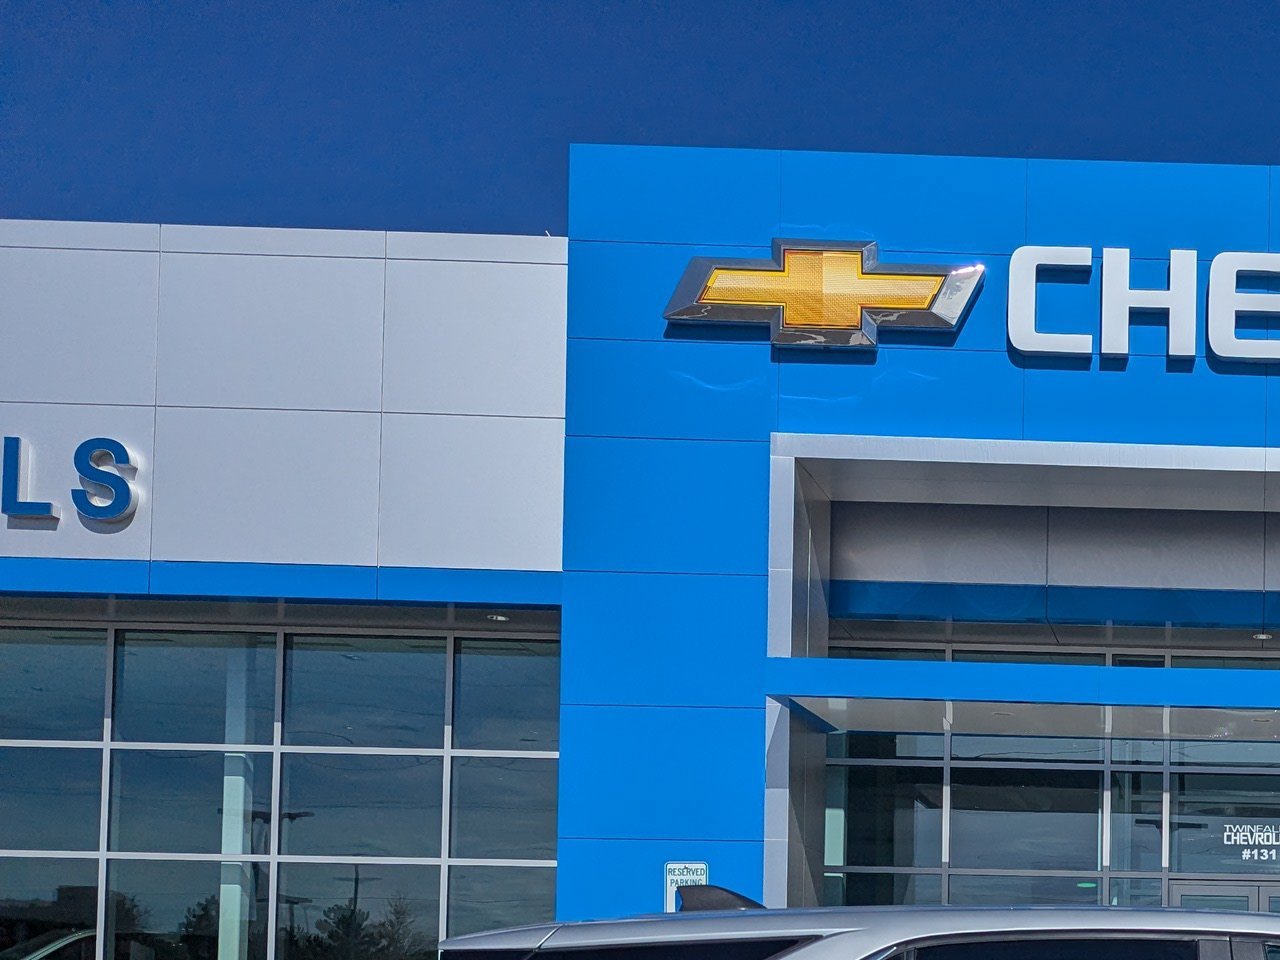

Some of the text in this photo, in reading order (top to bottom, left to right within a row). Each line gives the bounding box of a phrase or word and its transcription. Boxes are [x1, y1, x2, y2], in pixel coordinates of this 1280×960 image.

[1241, 848, 1277, 860] #131
[668, 867, 705, 877] RESERVED
[670, 878, 703, 887] PARKING
